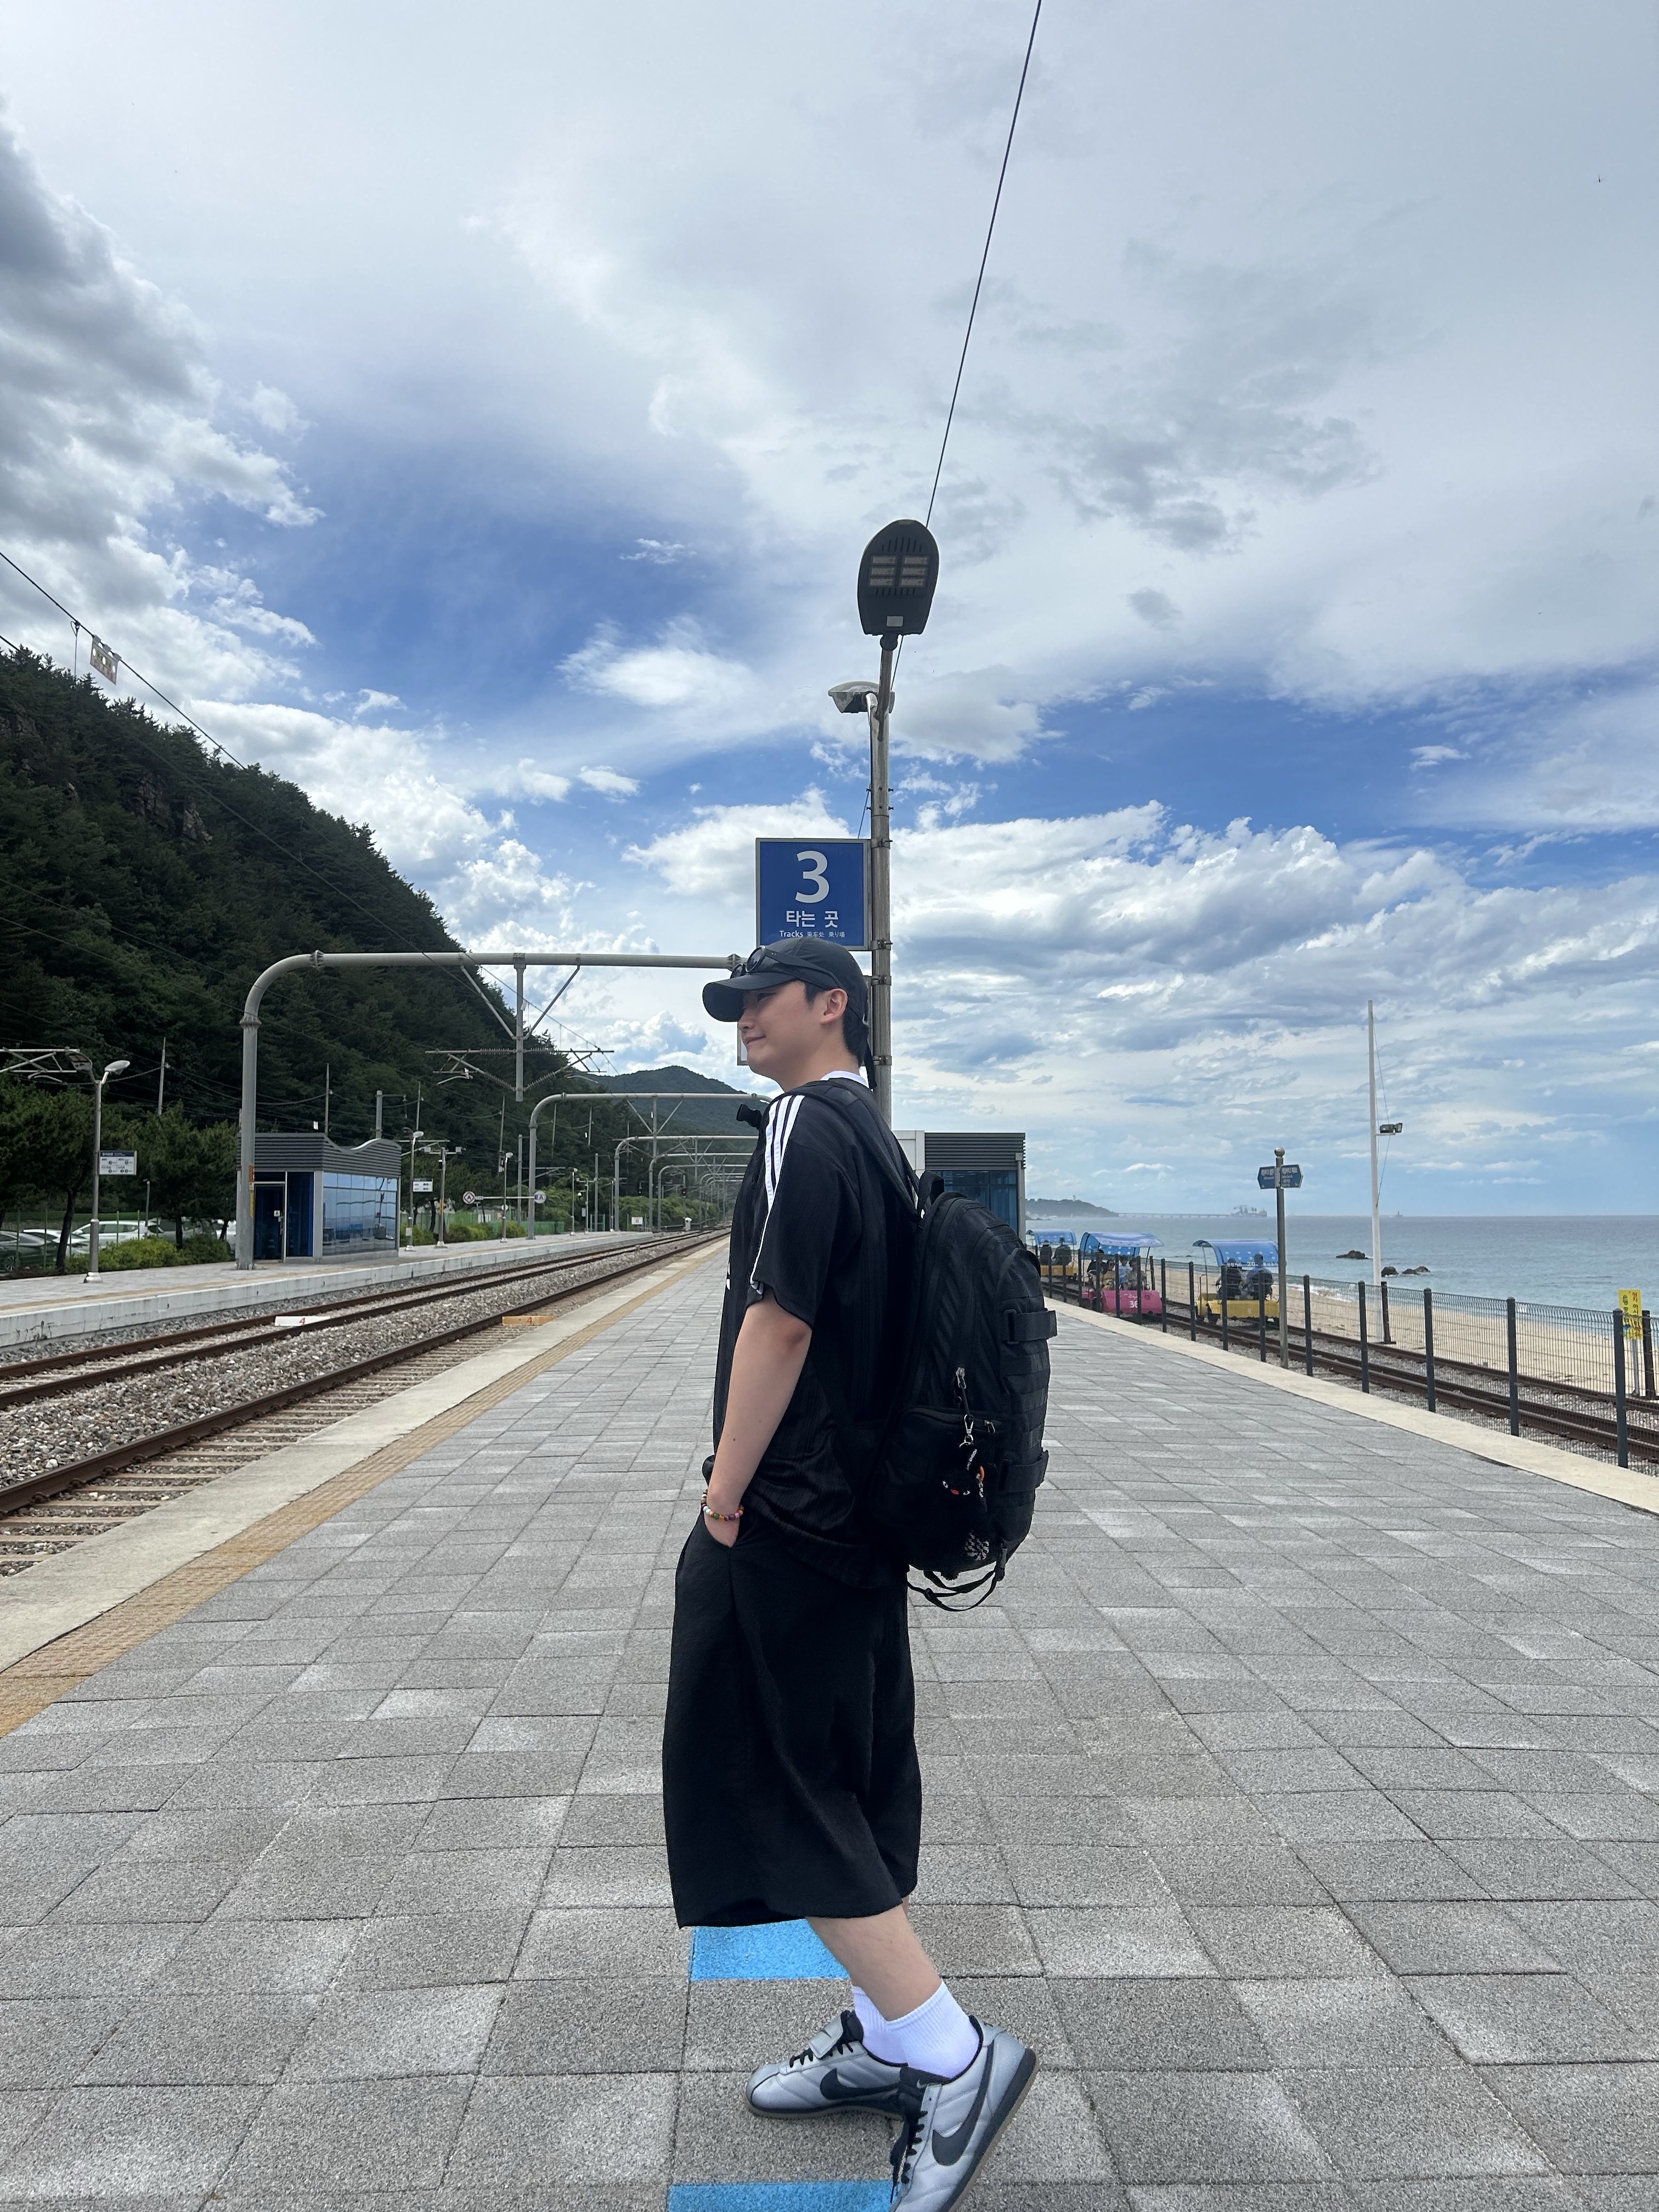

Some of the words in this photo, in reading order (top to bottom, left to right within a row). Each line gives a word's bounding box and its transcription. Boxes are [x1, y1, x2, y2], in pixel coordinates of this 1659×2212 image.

[795, 850, 830, 904] 3
[786, 910, 815, 927] 타는
[824, 910, 839, 928] 곳
[299, 1317, 306, 1325] 4
[527, 1317, 533, 1325] 4
